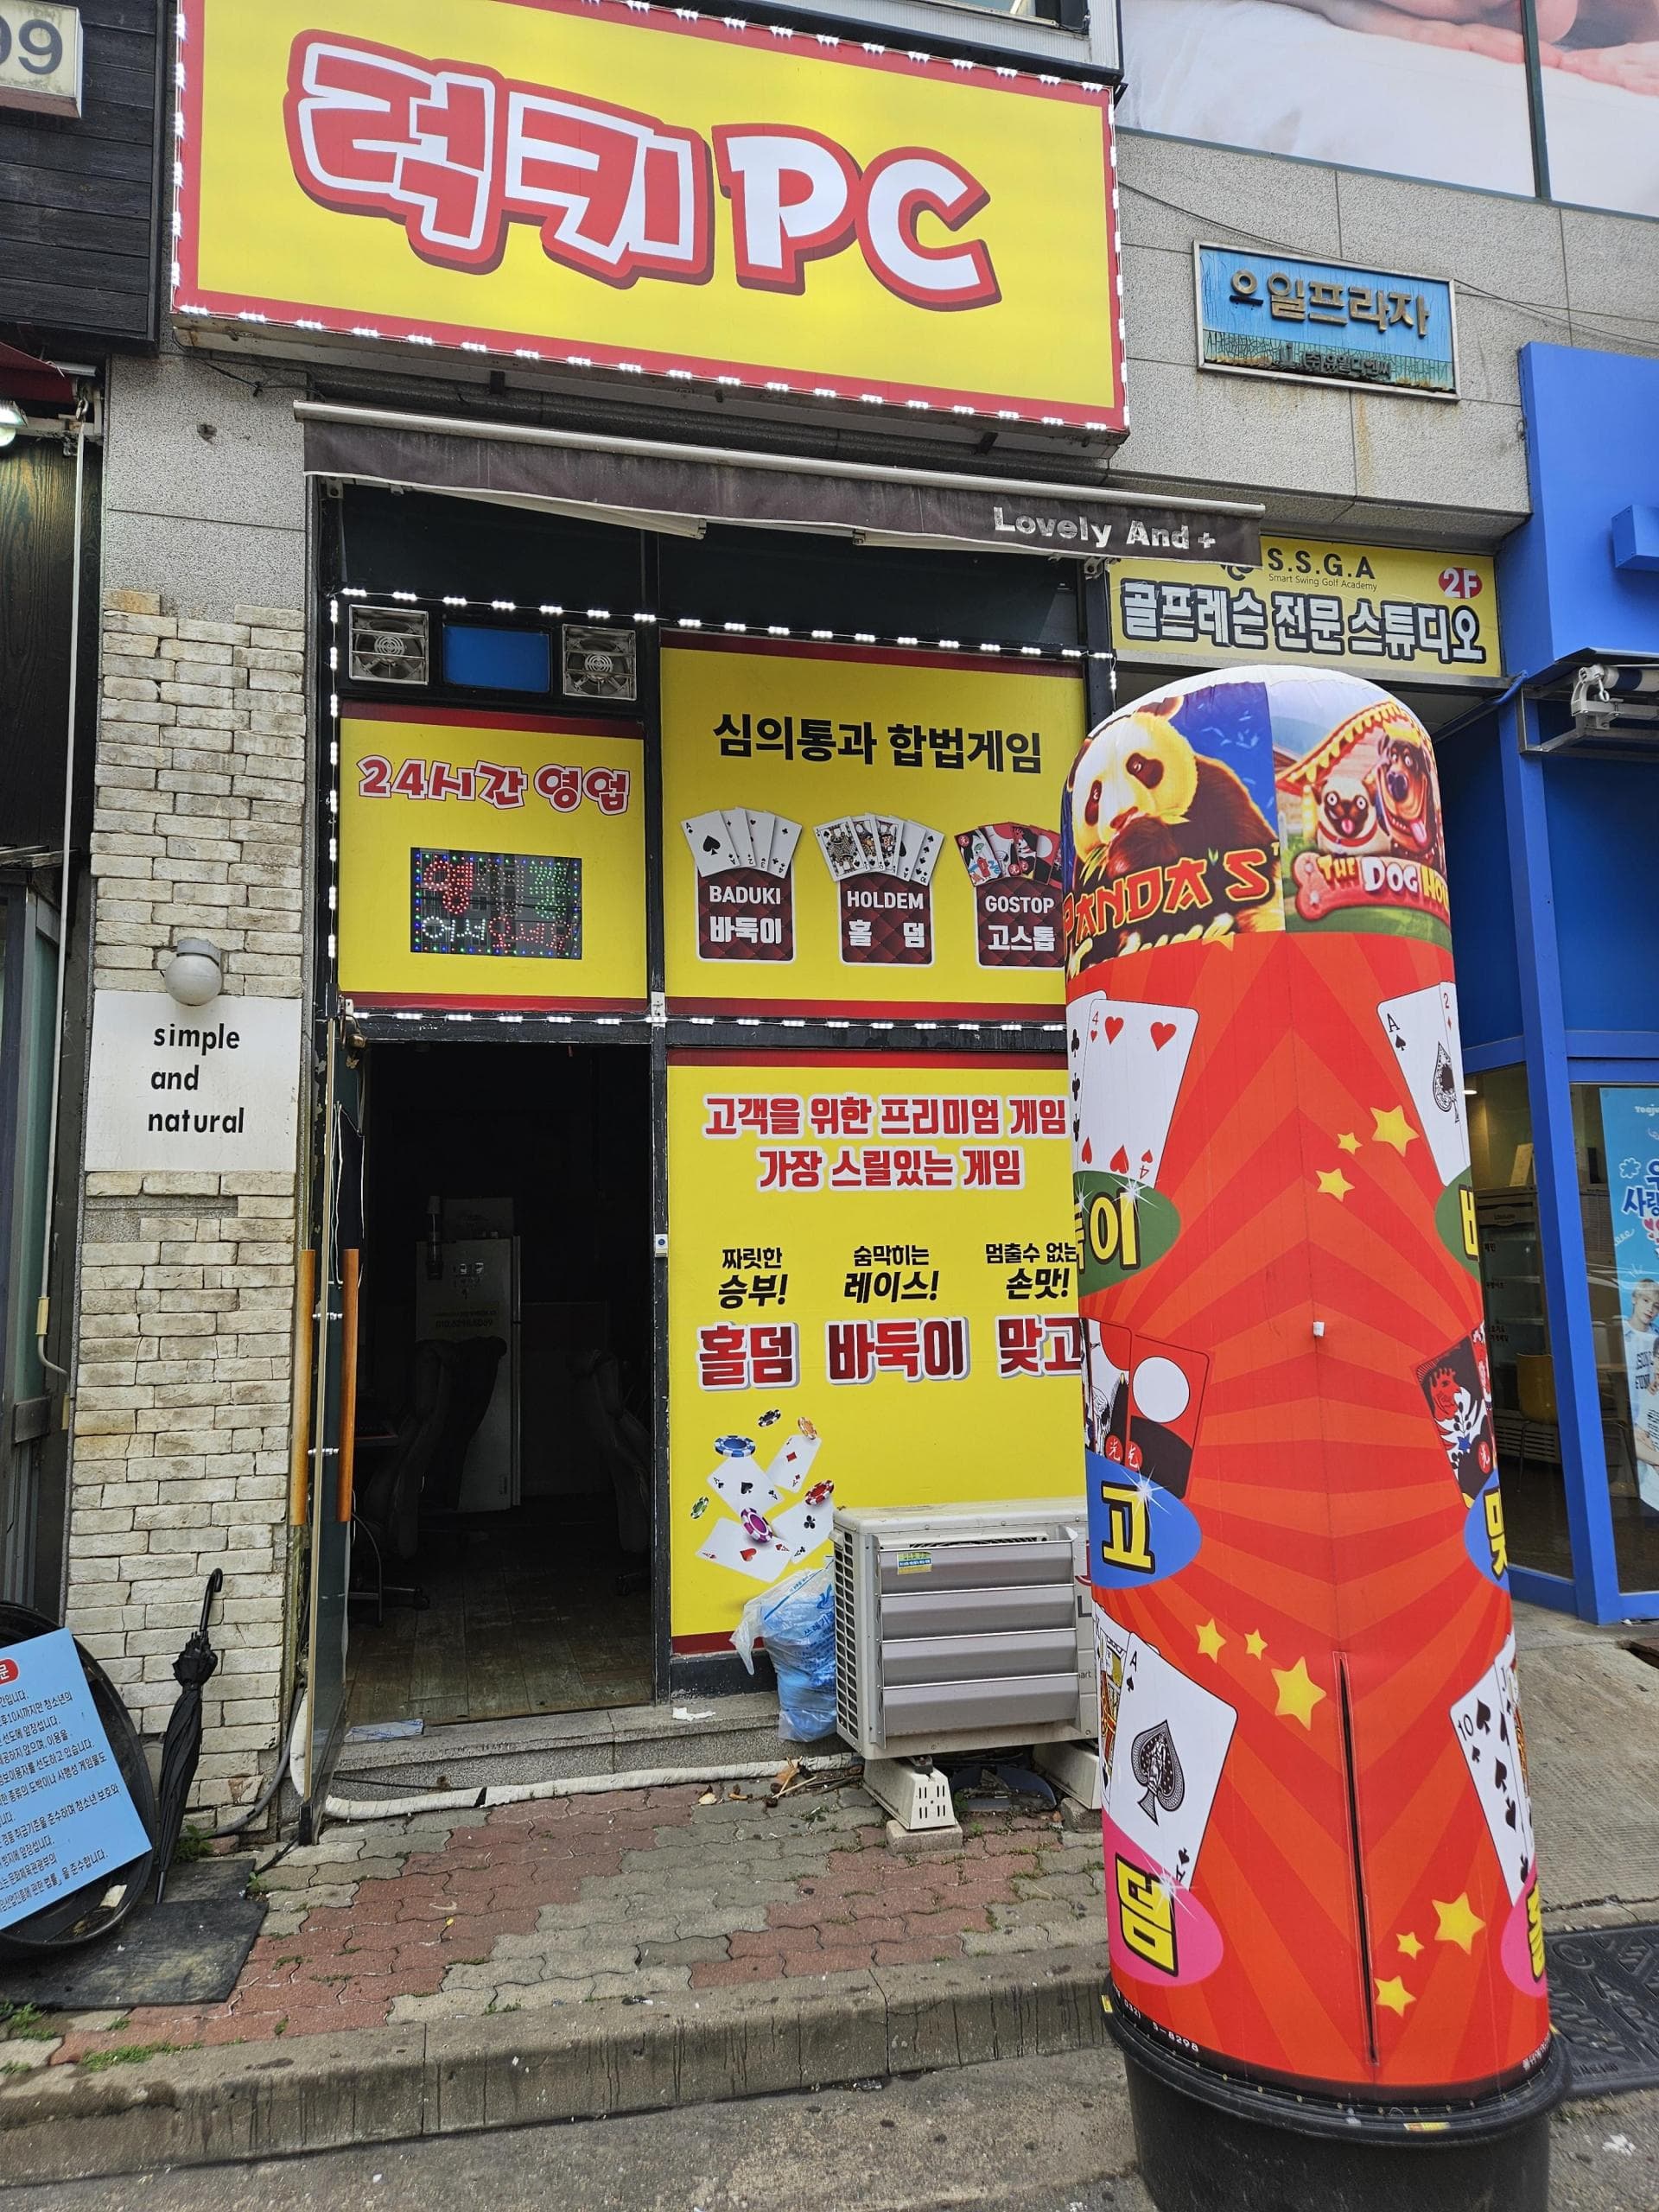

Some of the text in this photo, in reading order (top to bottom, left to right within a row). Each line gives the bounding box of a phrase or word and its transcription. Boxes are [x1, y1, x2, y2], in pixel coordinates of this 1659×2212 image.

[994, 505, 1112, 548] Lovely
[1126, 519, 1190, 550] And
[1268, 548, 1376, 580] S.S.G.A
[1268, 574, 1377, 592] Smart Swing Golf Academy
[1443, 568, 1478, 599] 2F
[1122, 580, 1485, 662] 골프레슨 전문 스튜디오
[712, 713, 1042, 774] 심의통과 합법게임
[357, 755, 630, 816] 24시간 영업
[1361, 856, 1419, 893] DOG
[709, 885, 782, 905] BADUKI
[847, 890, 924, 910] HOLDEM
[985, 896, 1055, 914] GOSTOP
[709, 916, 782, 944] 바둑이
[988, 925, 1056, 951] 고스톱
[1387, 1013, 1401, 1033] A
[153, 1023, 240, 1056] simple
[150, 1065, 200, 1090] and
[148, 1107, 245, 1134] natural
[704, 1094, 1067, 1136] 고객을 위한 프리미엄 게임
[759, 1149, 1021, 1188] 가장 스릴있는 게임
[722, 1247, 783, 1269] 짜릿한
[853, 1246, 930, 1267] 숨막히는
[985, 1243, 1077, 1265] 멈출수 없는
[718, 1274, 788, 1309] 승부!
[843, 1271, 939, 1303] 레이스!
[1006, 1268, 1069, 1300] 손맛!
[699, 1323, 798, 1389] 홀덤
[827, 1318, 967, 1382] 바둑이
[997, 1317, 1082, 1376] 맞고
[1129, 1650, 1138, 1672] A
[44, 1691, 73, 1711] 청소년의
[47, 1729, 69, 1745] 이용을
[1458, 1713, 1474, 1741] 10
[36, 1751, 66, 1771] 선도하고
[64, 1738, 95, 1758] 있습니다.
[9, 1784, 29, 1803] 종류의
[29, 1773, 58, 1795] 도박이나
[58, 1765, 79, 1783] 사행성
[48, 1803, 76, 1823] 준수하며
[76, 1794, 98, 1813] 청소년
[98, 1783, 120, 1801] 보호와
[70, 1848, 109, 1876] 준수합니다.
